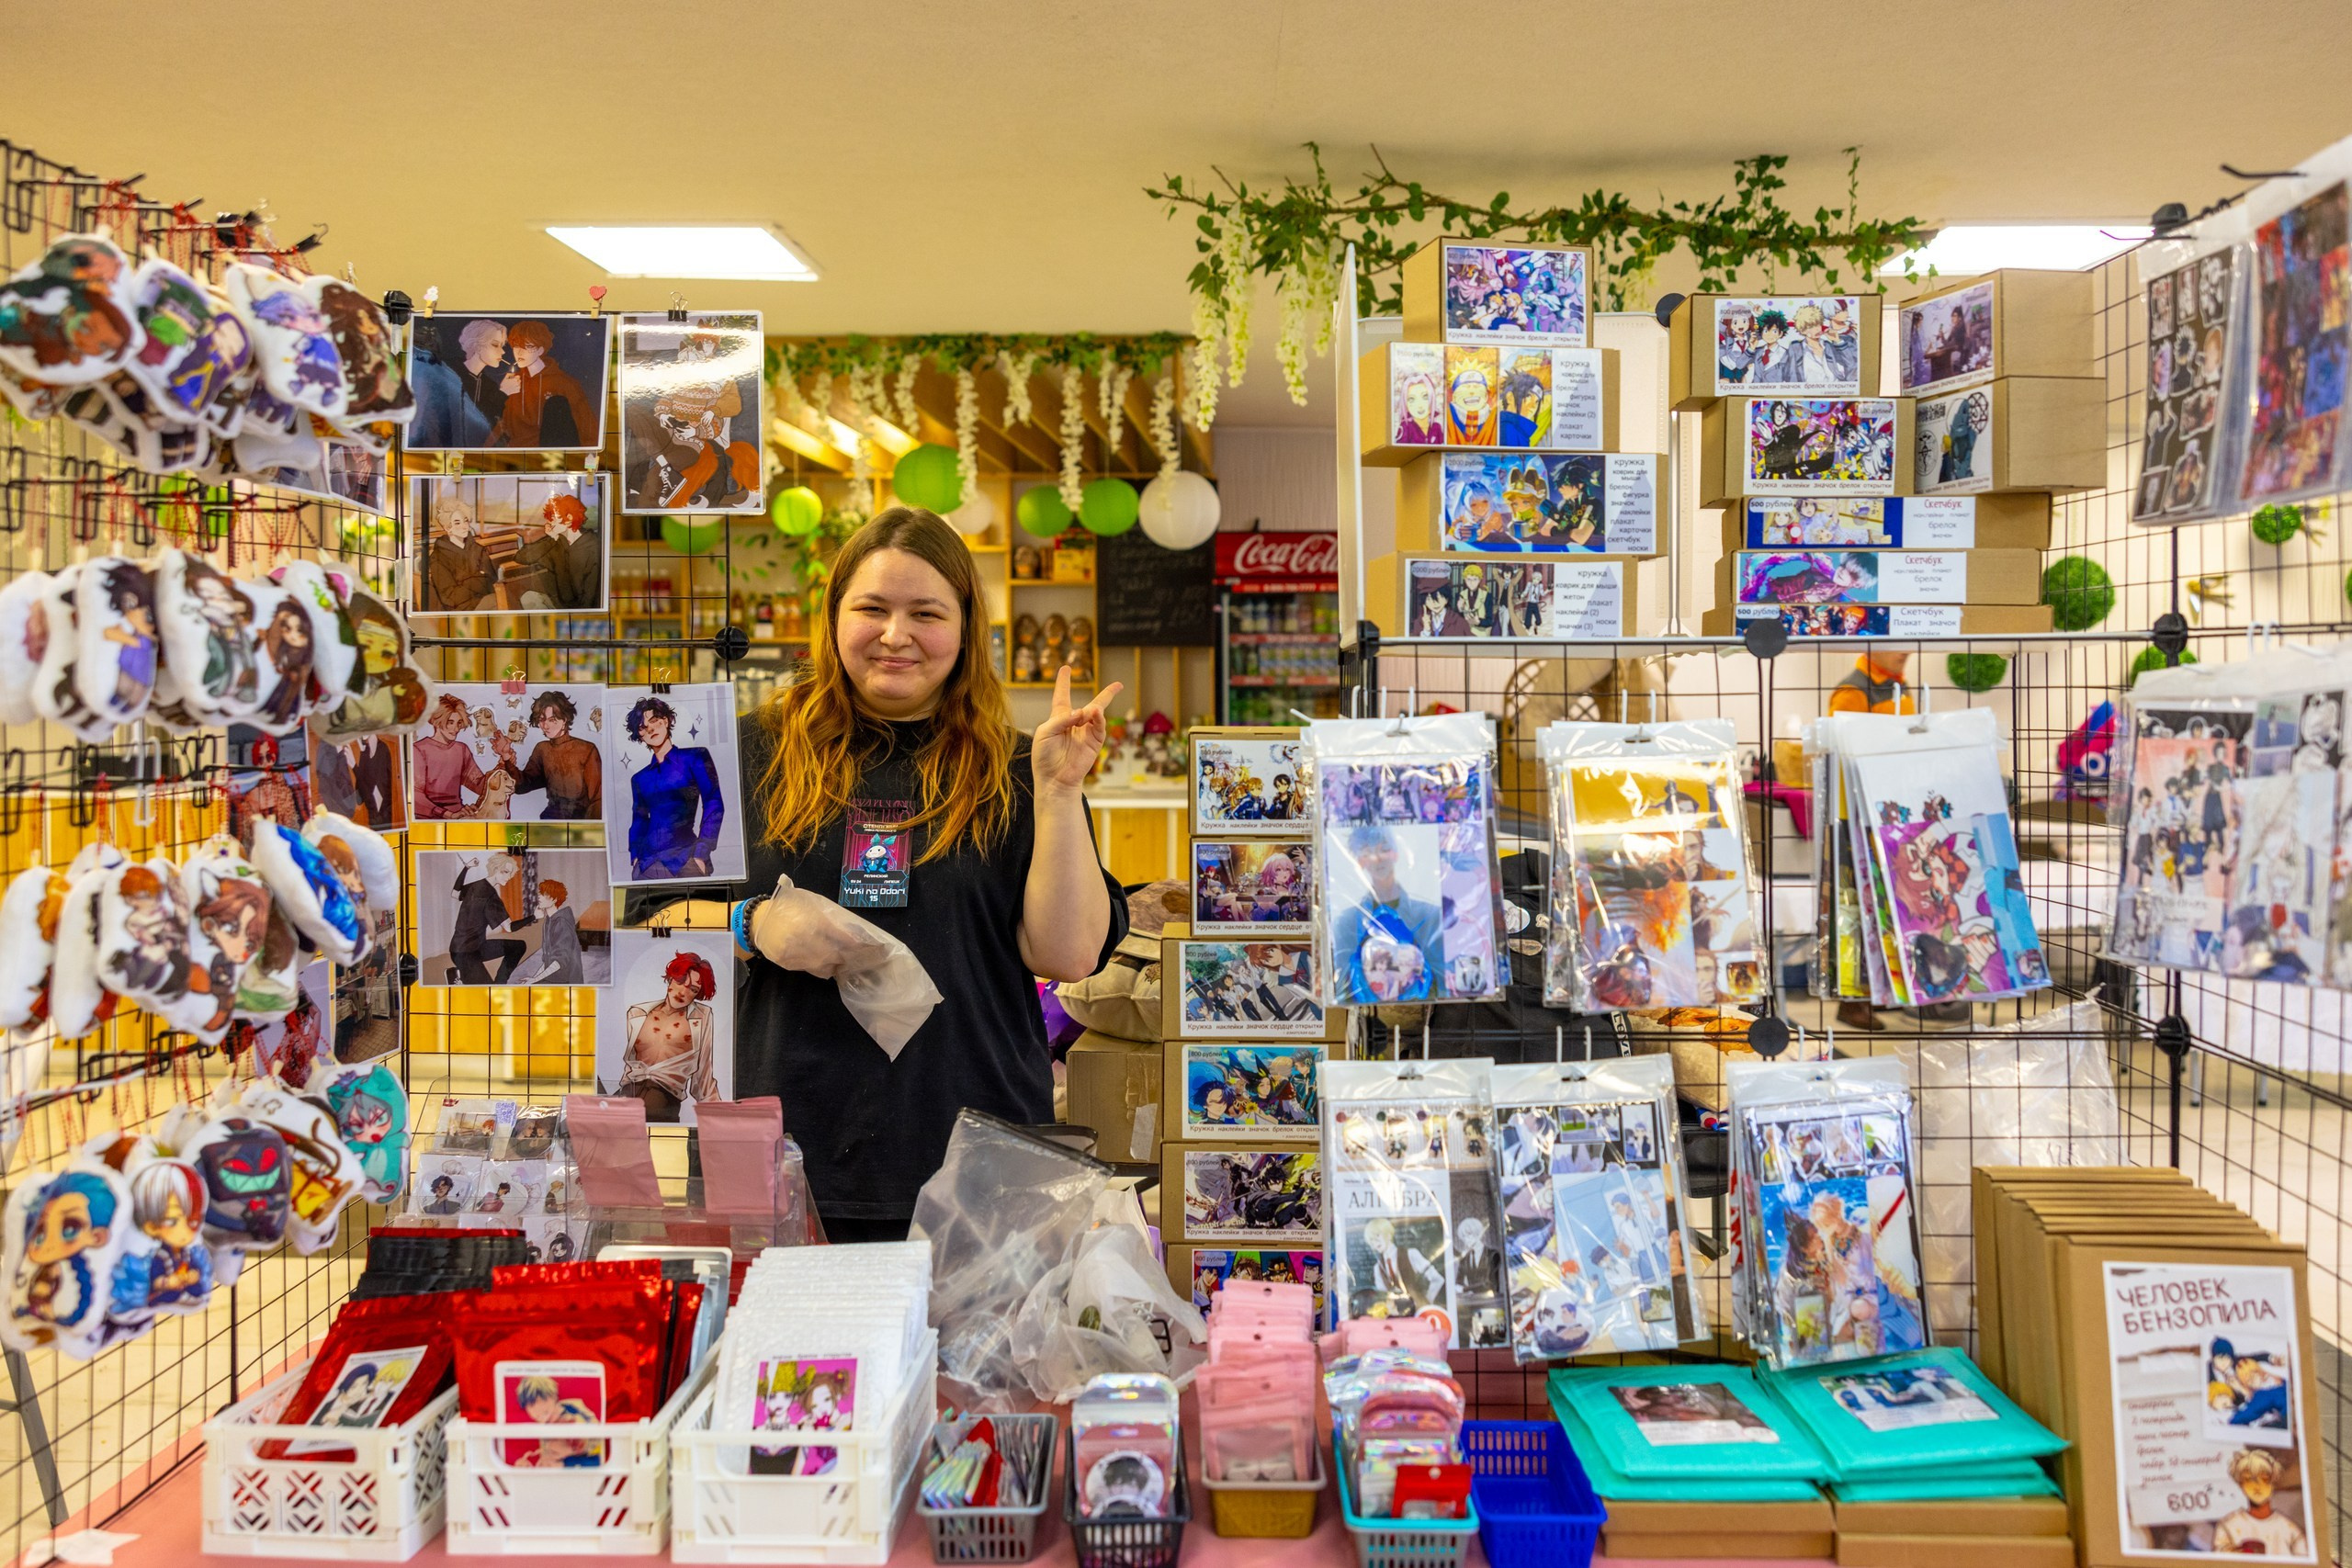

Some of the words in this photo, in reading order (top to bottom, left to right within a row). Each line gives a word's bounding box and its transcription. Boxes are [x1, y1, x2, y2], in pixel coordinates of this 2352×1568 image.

[1448, 331, 1472, 340] Кружка
[1560, 361, 1589, 369] кружка
[1766, 500, 1793, 509] рублей
[1924, 499, 1962, 511] Скетчбук
[1928, 521, 1957, 529] брелок
[1905, 555, 1942, 566] Скетчбук
[1914, 575, 1942, 583] брелок
[1589, 608, 1600, 617] (2)
[1753, 608, 1780, 616] рублей
[1900, 607, 1944, 617] Скетчбук
[1583, 623, 1594, 631] (3)
[735, 900, 746, 930] СТНИК
[2117, 1277, 2231, 1309] ЧЕЛОВЕК
[2122, 1299, 2278, 1334] БЕНЗОПИЛА
[2166, 1490, 2211, 1513] 600
